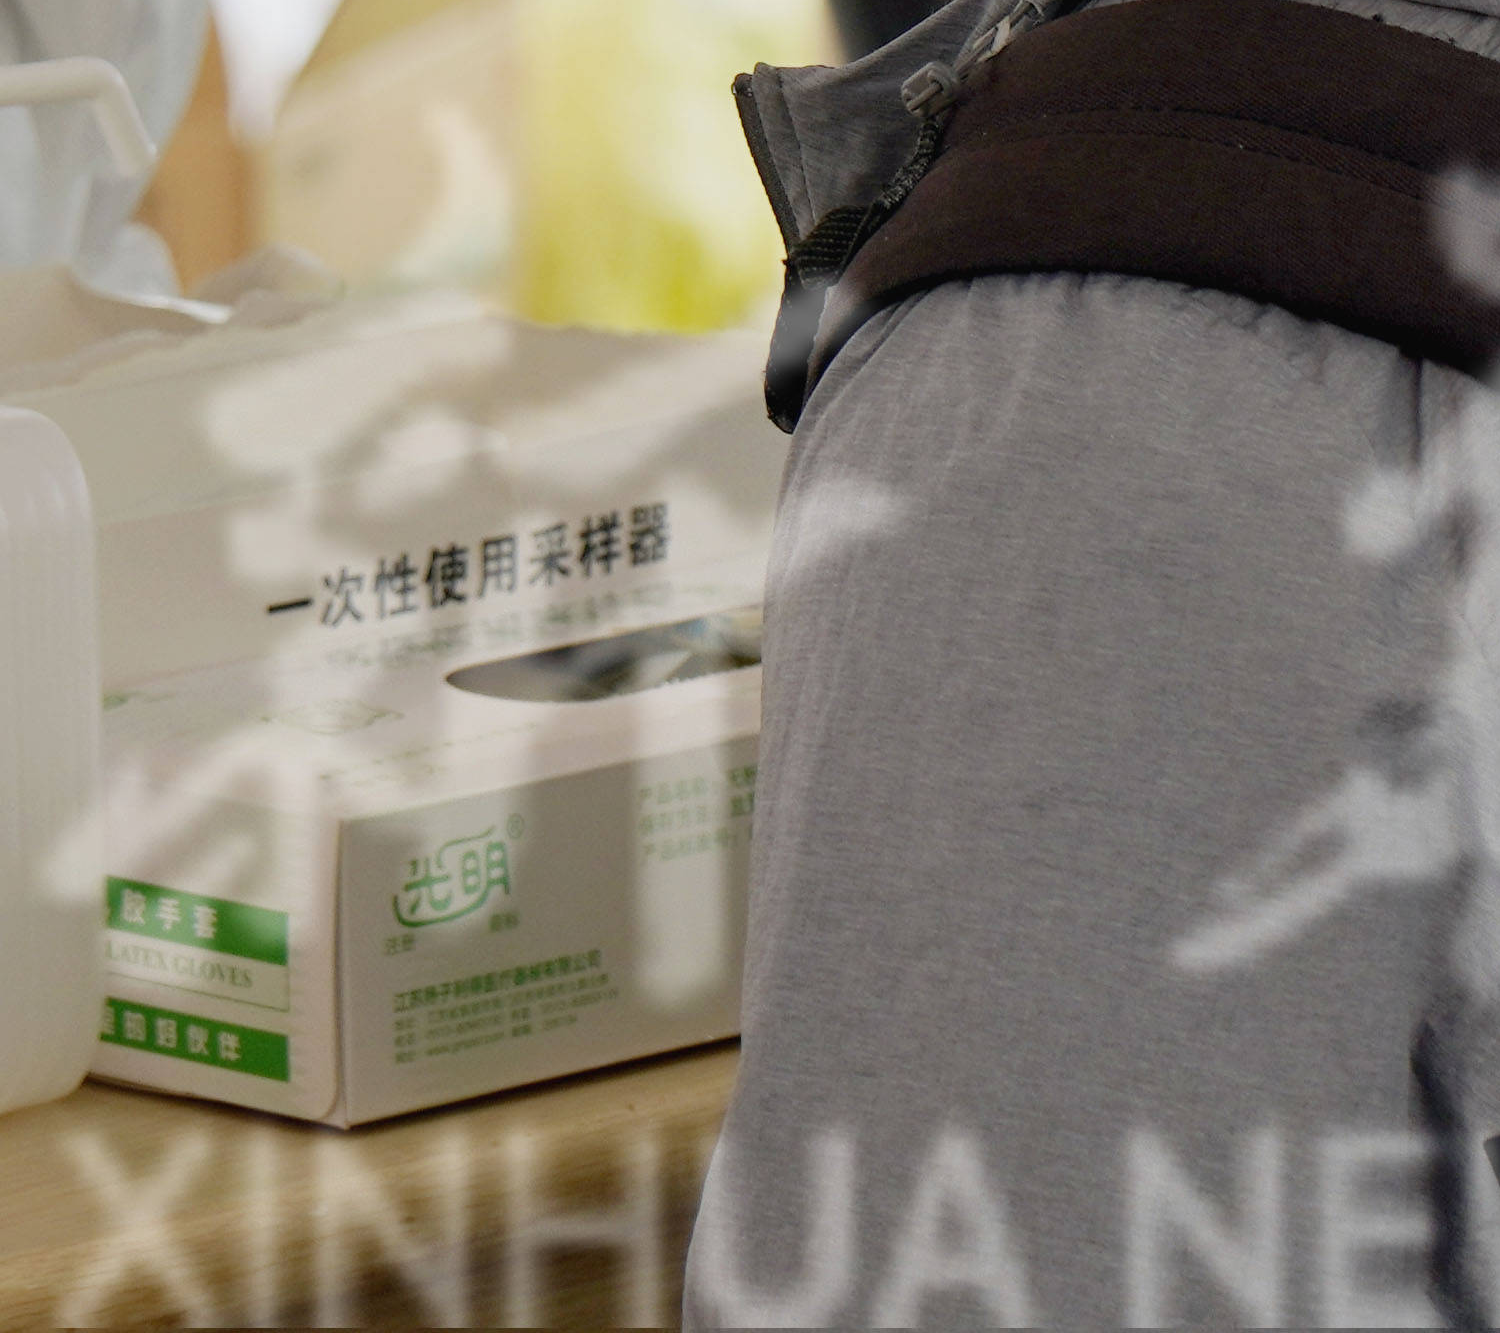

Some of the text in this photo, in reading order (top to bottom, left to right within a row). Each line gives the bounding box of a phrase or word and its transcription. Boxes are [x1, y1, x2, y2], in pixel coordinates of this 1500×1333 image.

[266, 502, 671, 627] 一次性使用采样器
[396, 831, 511, 924] 光明
